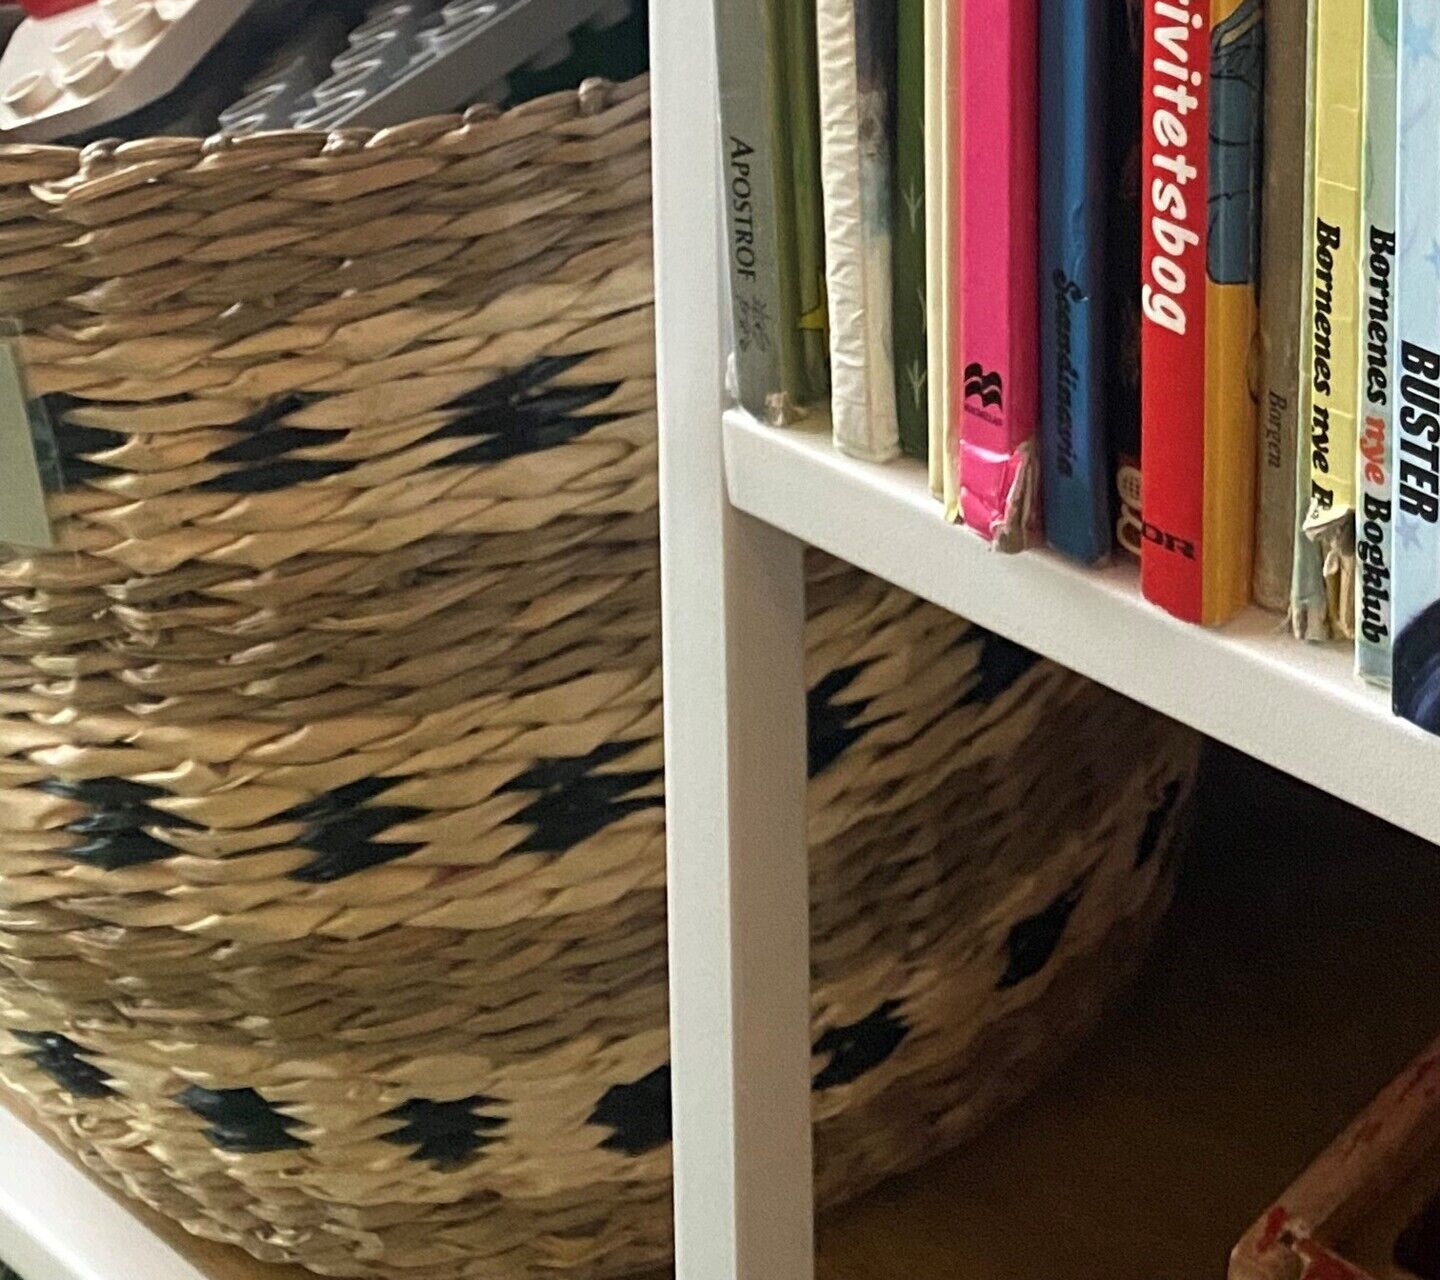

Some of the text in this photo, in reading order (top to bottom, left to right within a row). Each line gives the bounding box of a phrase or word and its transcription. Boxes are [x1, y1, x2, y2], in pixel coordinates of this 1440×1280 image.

[730, 136, 757, 283] APOSTROF
[1266, 389, 1288, 468] Borgen
[1311, 404, 1333, 473] nye
[1357, 225, 1396, 644] Børnenes nye Bogklub
[1399, 340, 1440, 523] BUSTER
